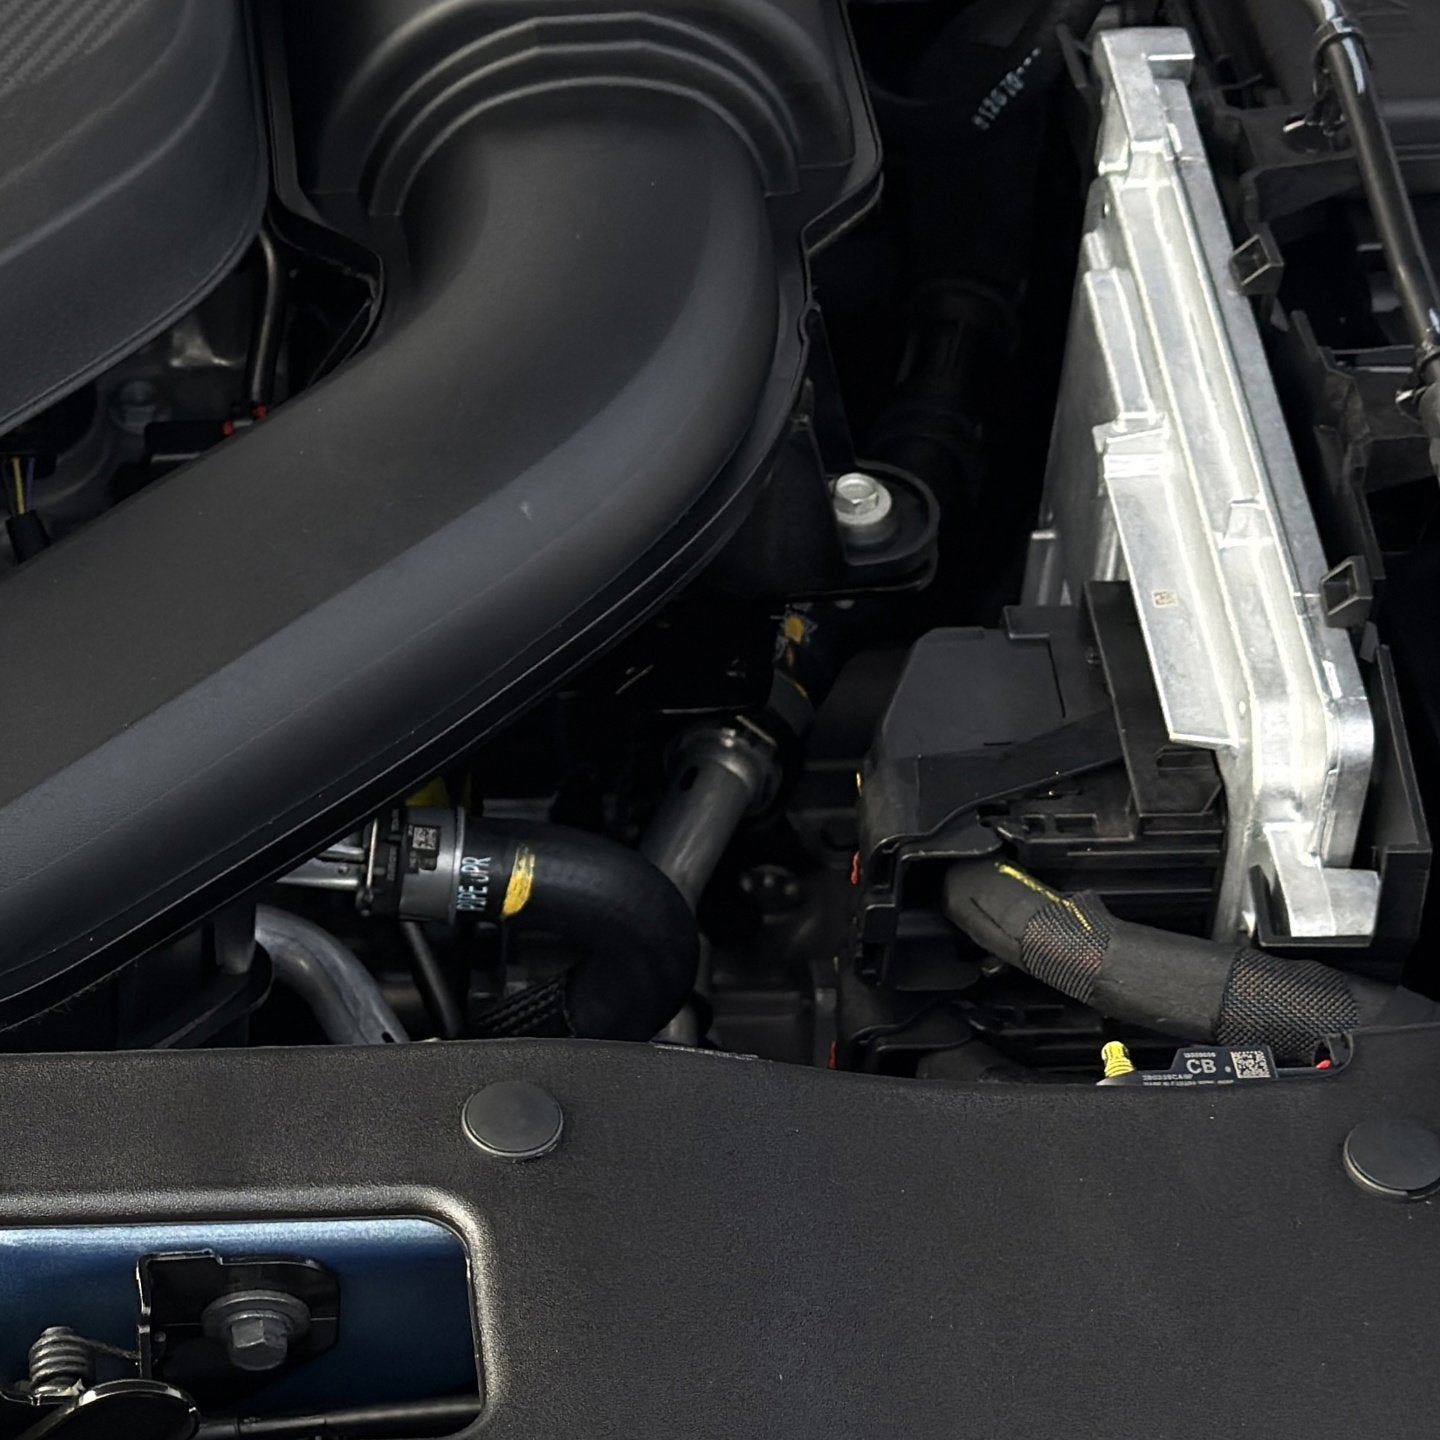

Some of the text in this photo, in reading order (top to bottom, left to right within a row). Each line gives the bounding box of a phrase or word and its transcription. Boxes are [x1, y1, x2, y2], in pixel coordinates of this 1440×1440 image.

[456, 856, 491, 911] PIPE UPR
[1186, 1058, 1216, 1074] CB
